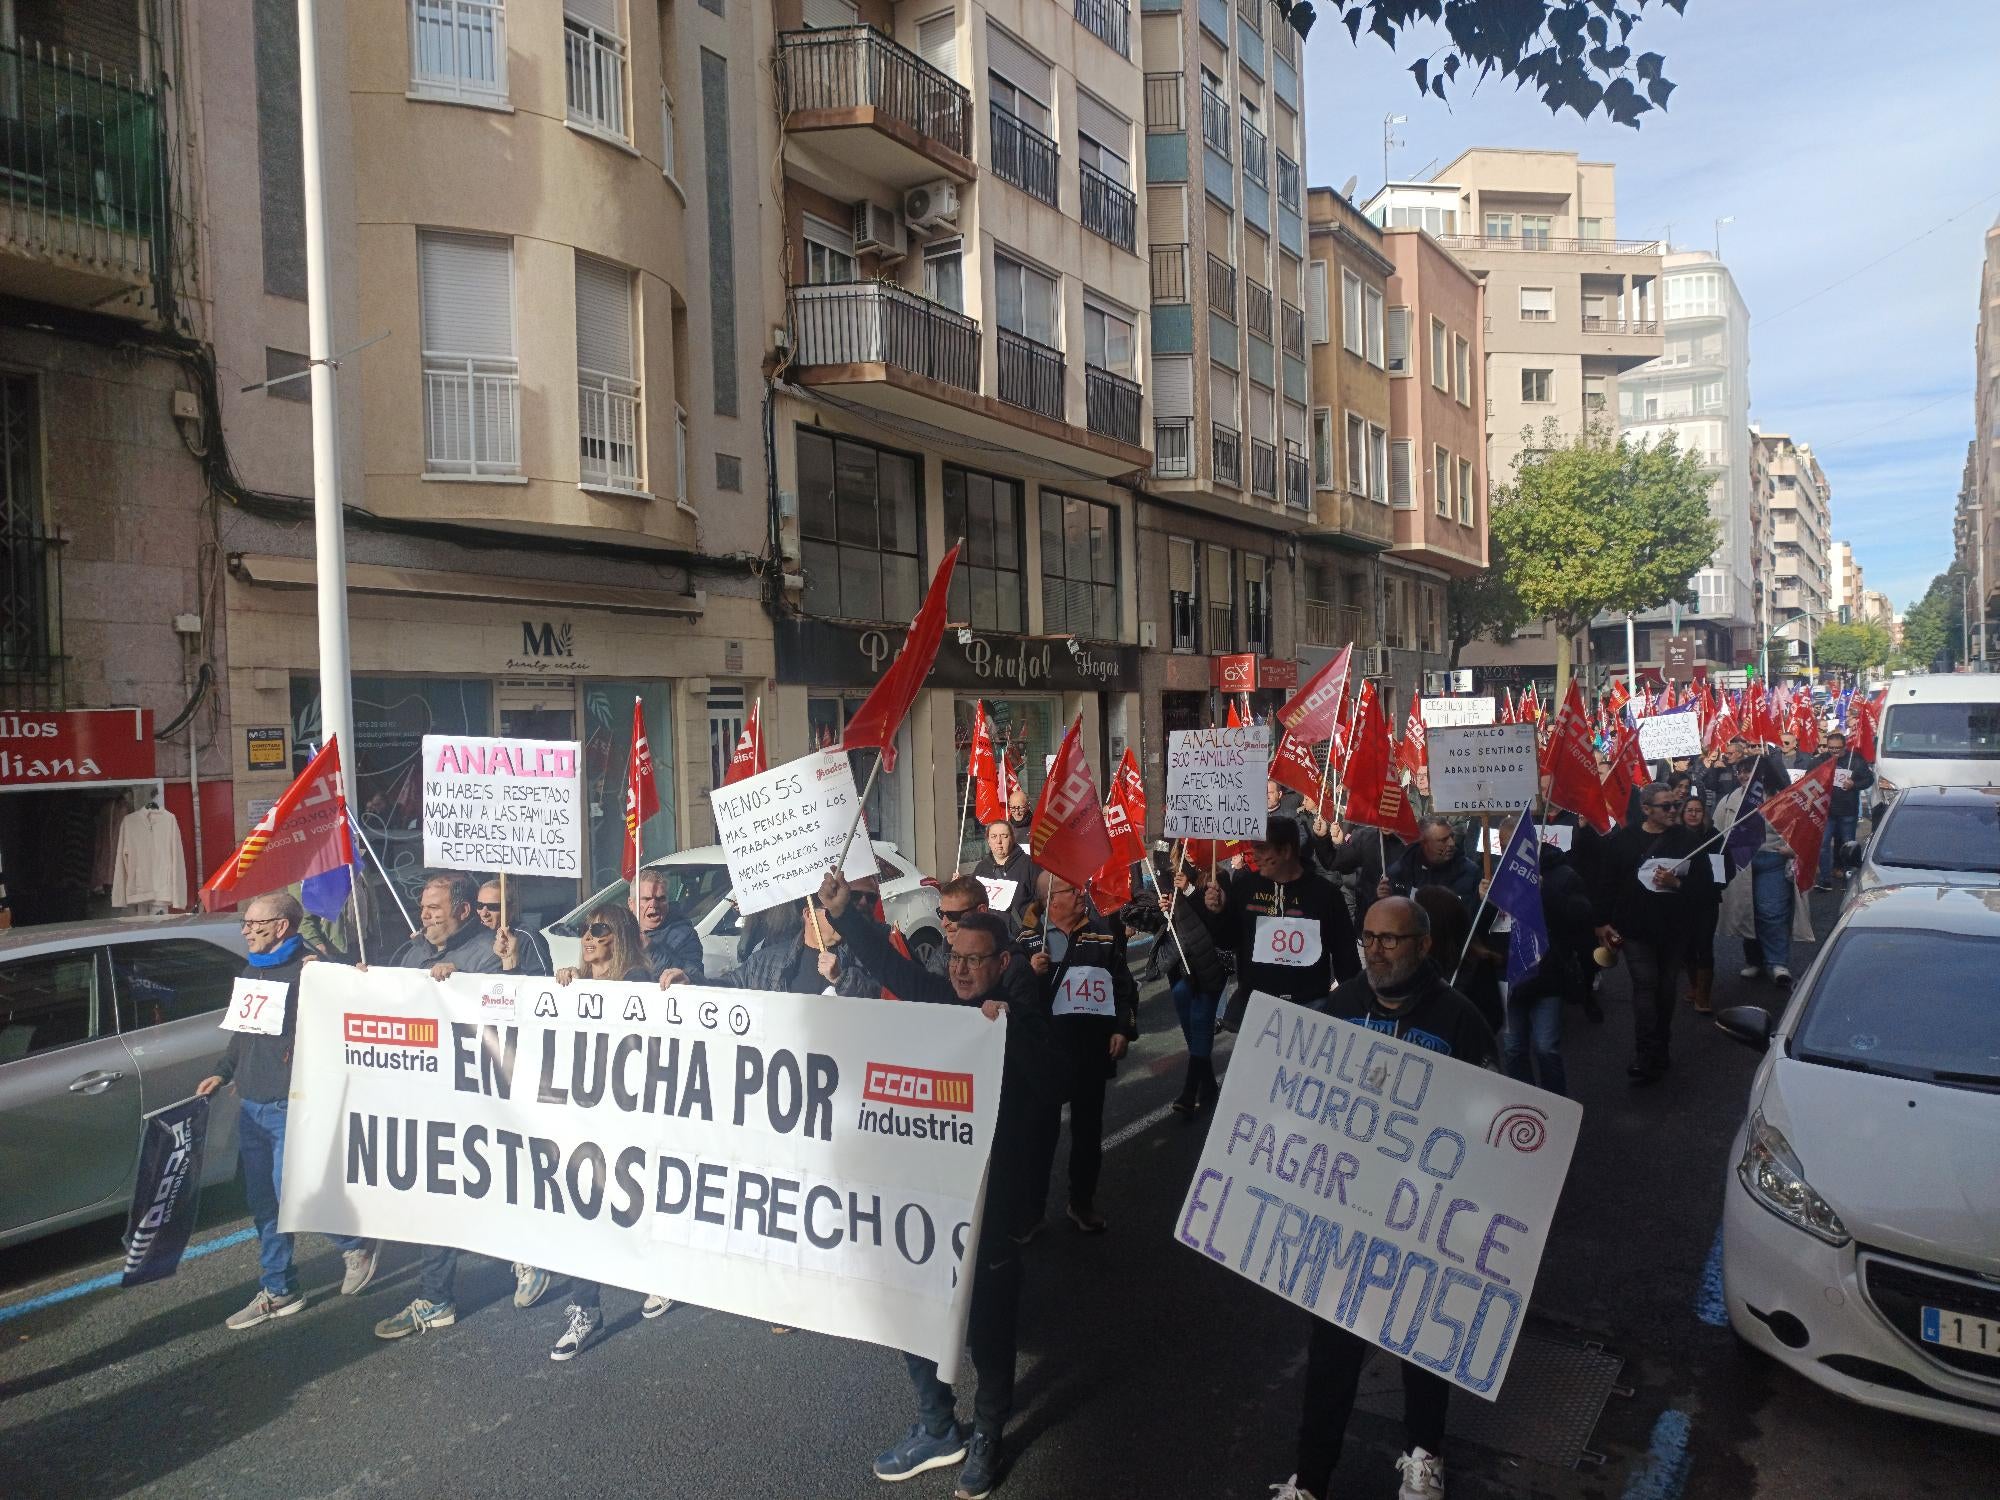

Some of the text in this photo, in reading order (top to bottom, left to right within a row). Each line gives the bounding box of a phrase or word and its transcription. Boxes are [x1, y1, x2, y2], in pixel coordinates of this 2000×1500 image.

[965, 638, 1052, 687] Brufal
[1181, 728, 1246, 750] ANALCO
[1463, 729, 1504, 737] ANALCO
[0, 751, 101, 777] liana
[436, 745, 575, 778] ANALCO
[1171, 750, 1245, 768] 300 FAMILIAS
[1450, 748, 1471, 756] NOS
[1182, 772, 1243, 789] AFECTADAS
[1445, 765, 1525, 774] ABANDONADOS
[427, 782, 441, 796] NO
[503, 786, 570, 803] RESPETADO
[719, 787, 770, 822] MENOS
[1219, 795, 1250, 812] HIJOS
[425, 802, 569, 825] NADA NI A LAS FAMILIAS
[726, 794, 847, 844] MAS PENSAR EN LOS
[1165, 816, 1261, 836] NO TIENEN CULPA
[427, 821, 565, 845] VULNERABLES NI A LOS
[733, 821, 821, 858] TRABAJADORES
[442, 842, 576, 870] REPRESENTANTES
[738, 830, 862, 881] MENOS CHALECOS NEGRS
[752, 880, 769, 891] MAS
[1271, 930, 1305, 954] 80
[1061, 979, 1106, 1002] 145
[240, 994, 268, 1020] 37
[534, 992, 750, 1035] ANALCO
[349, 1020, 406, 1040] CCOO
[345, 1044, 439, 1072] industria
[1254, 1008, 1435, 1112] ANALCO
[451, 1022, 840, 1142] EN LUCHA POR
[869, 1070, 932, 1101] CCOO
[858, 1103, 973, 1145] industria
[1269, 1066, 1466, 1180] MOROSO
[347, 1112, 646, 1228] NUESTROS
[1181, 1168, 1523, 1393] EL TRAMPOSO
